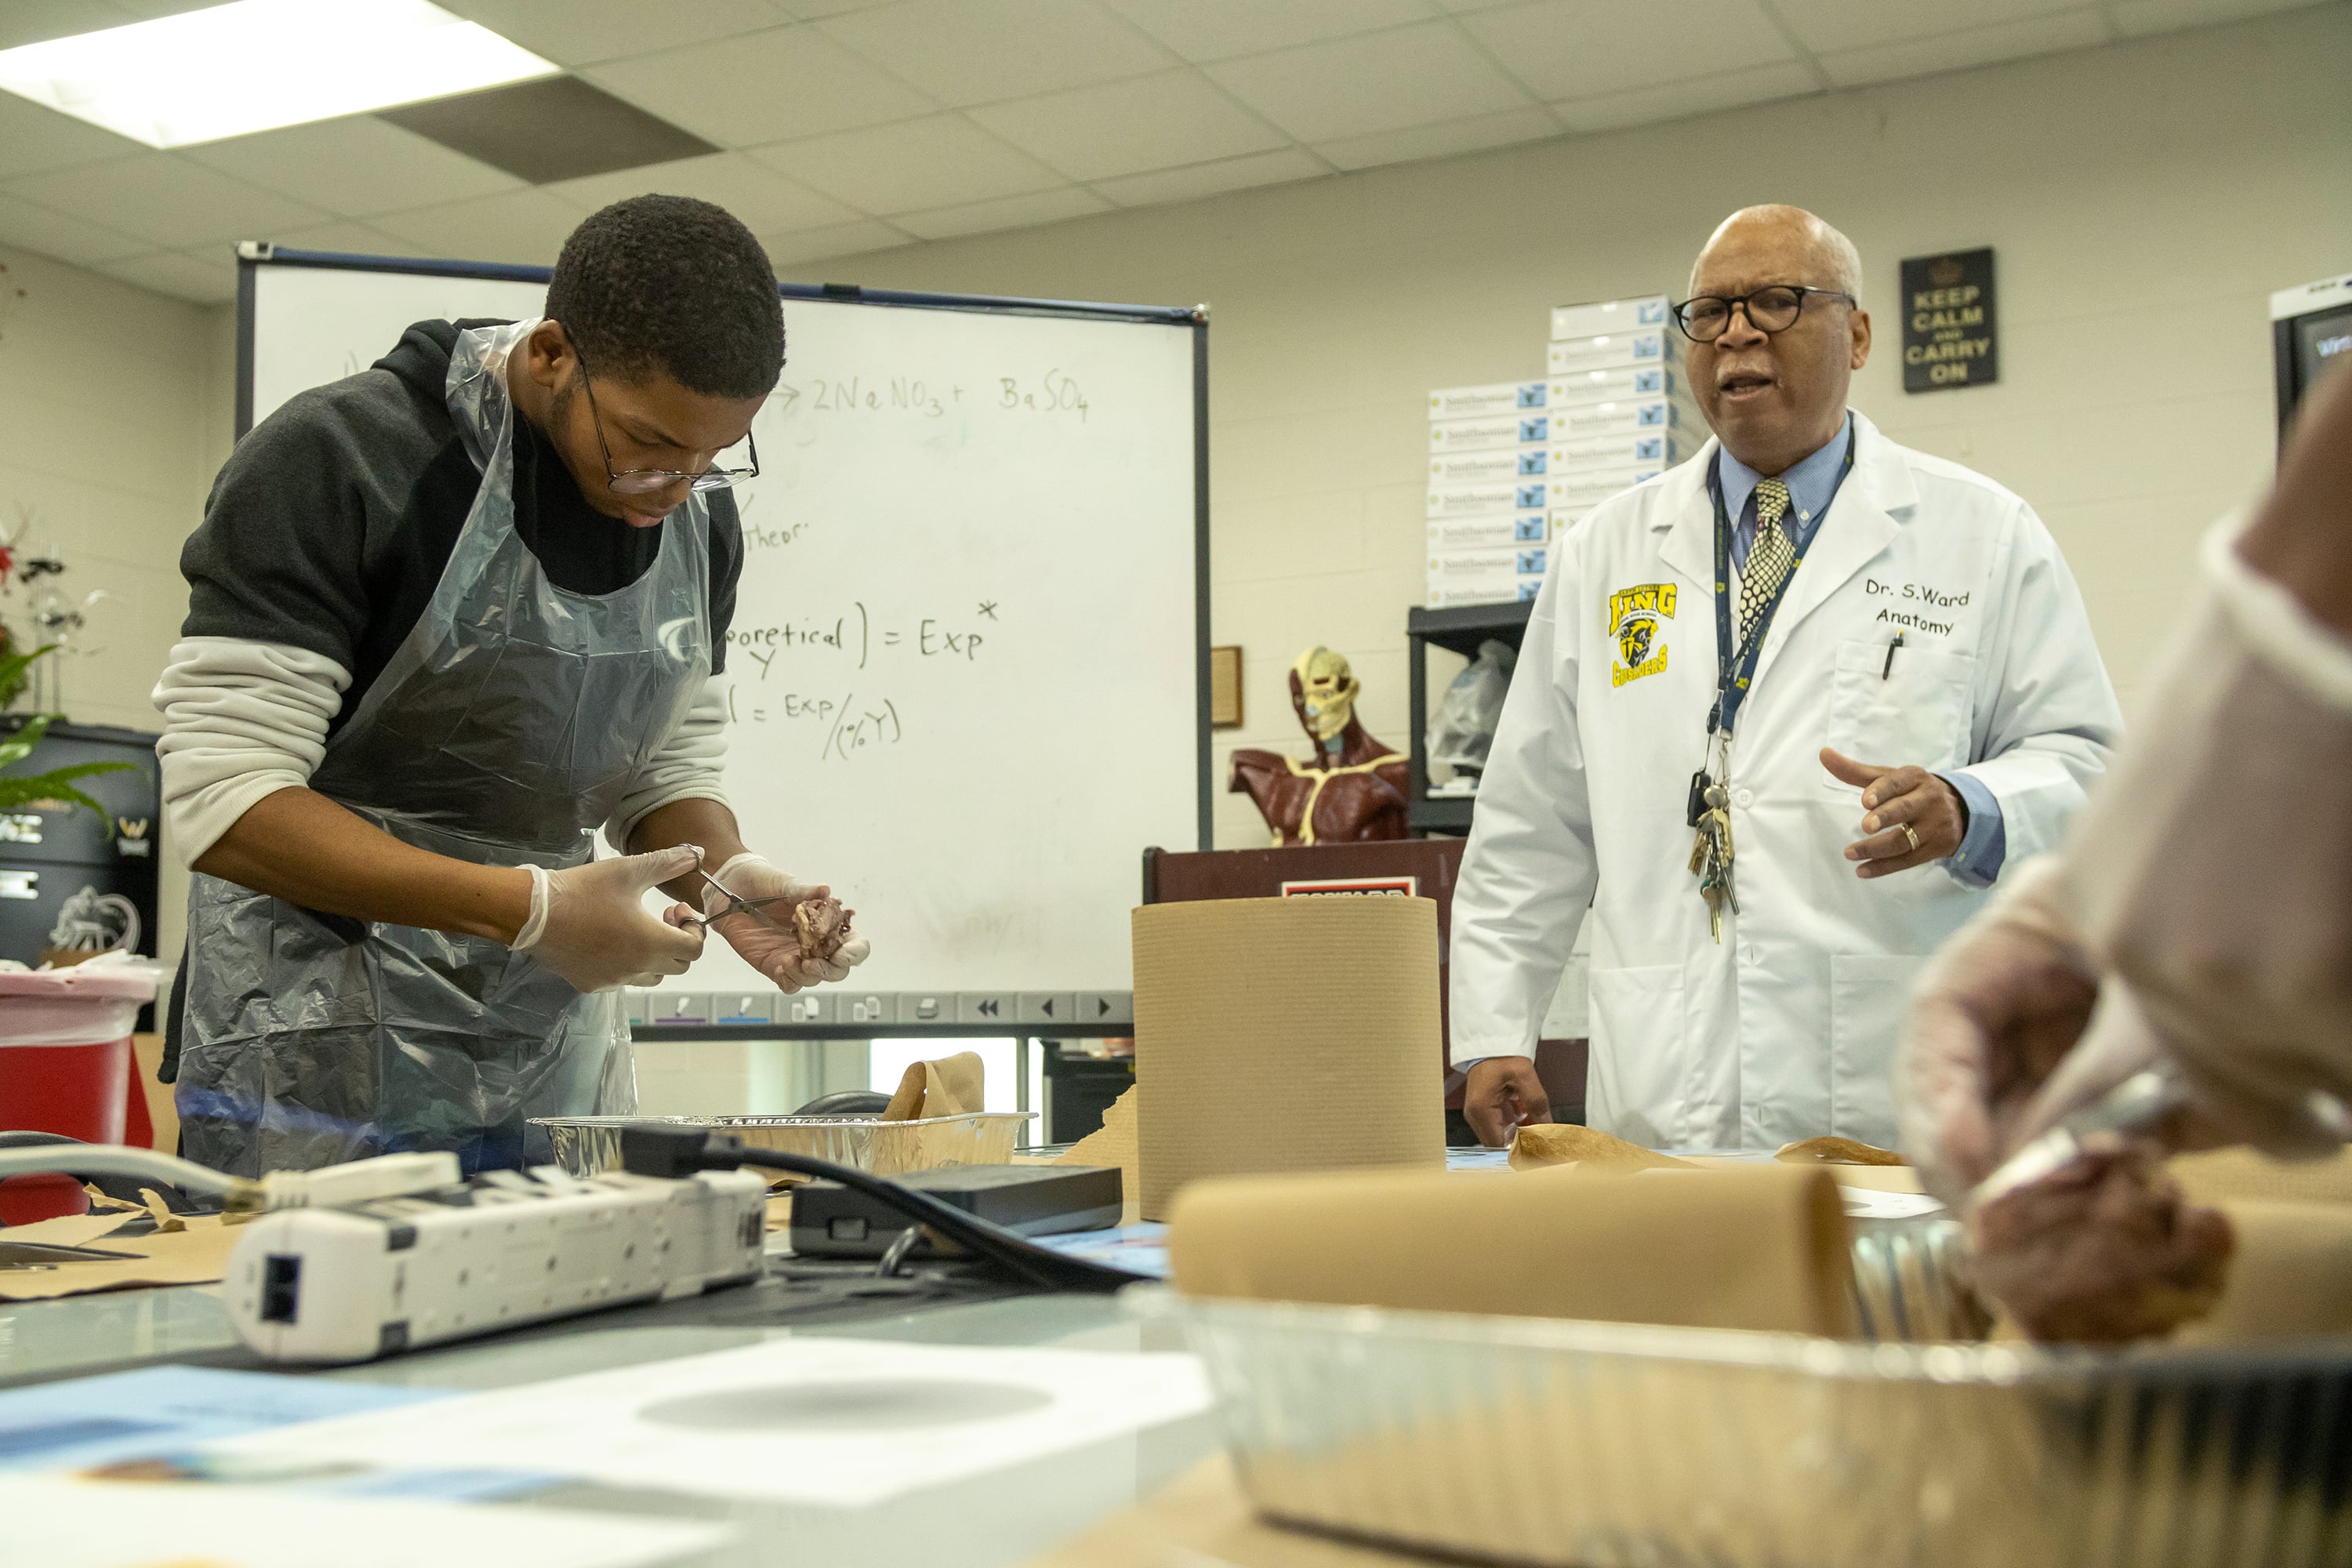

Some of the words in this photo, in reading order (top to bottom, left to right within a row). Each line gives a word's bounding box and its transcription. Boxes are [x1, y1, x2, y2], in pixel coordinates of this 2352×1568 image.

[1914, 285, 1980, 310] KEEP
[1911, 306, 1984, 333] CALM
[1905, 338, 1990, 365] CARRY
[1929, 362, 1969, 383] ON
[1866, 579, 1893, 596] Dr.
[1876, 608, 1954, 637] Anatomy
[750, 648, 776, 680] Y
